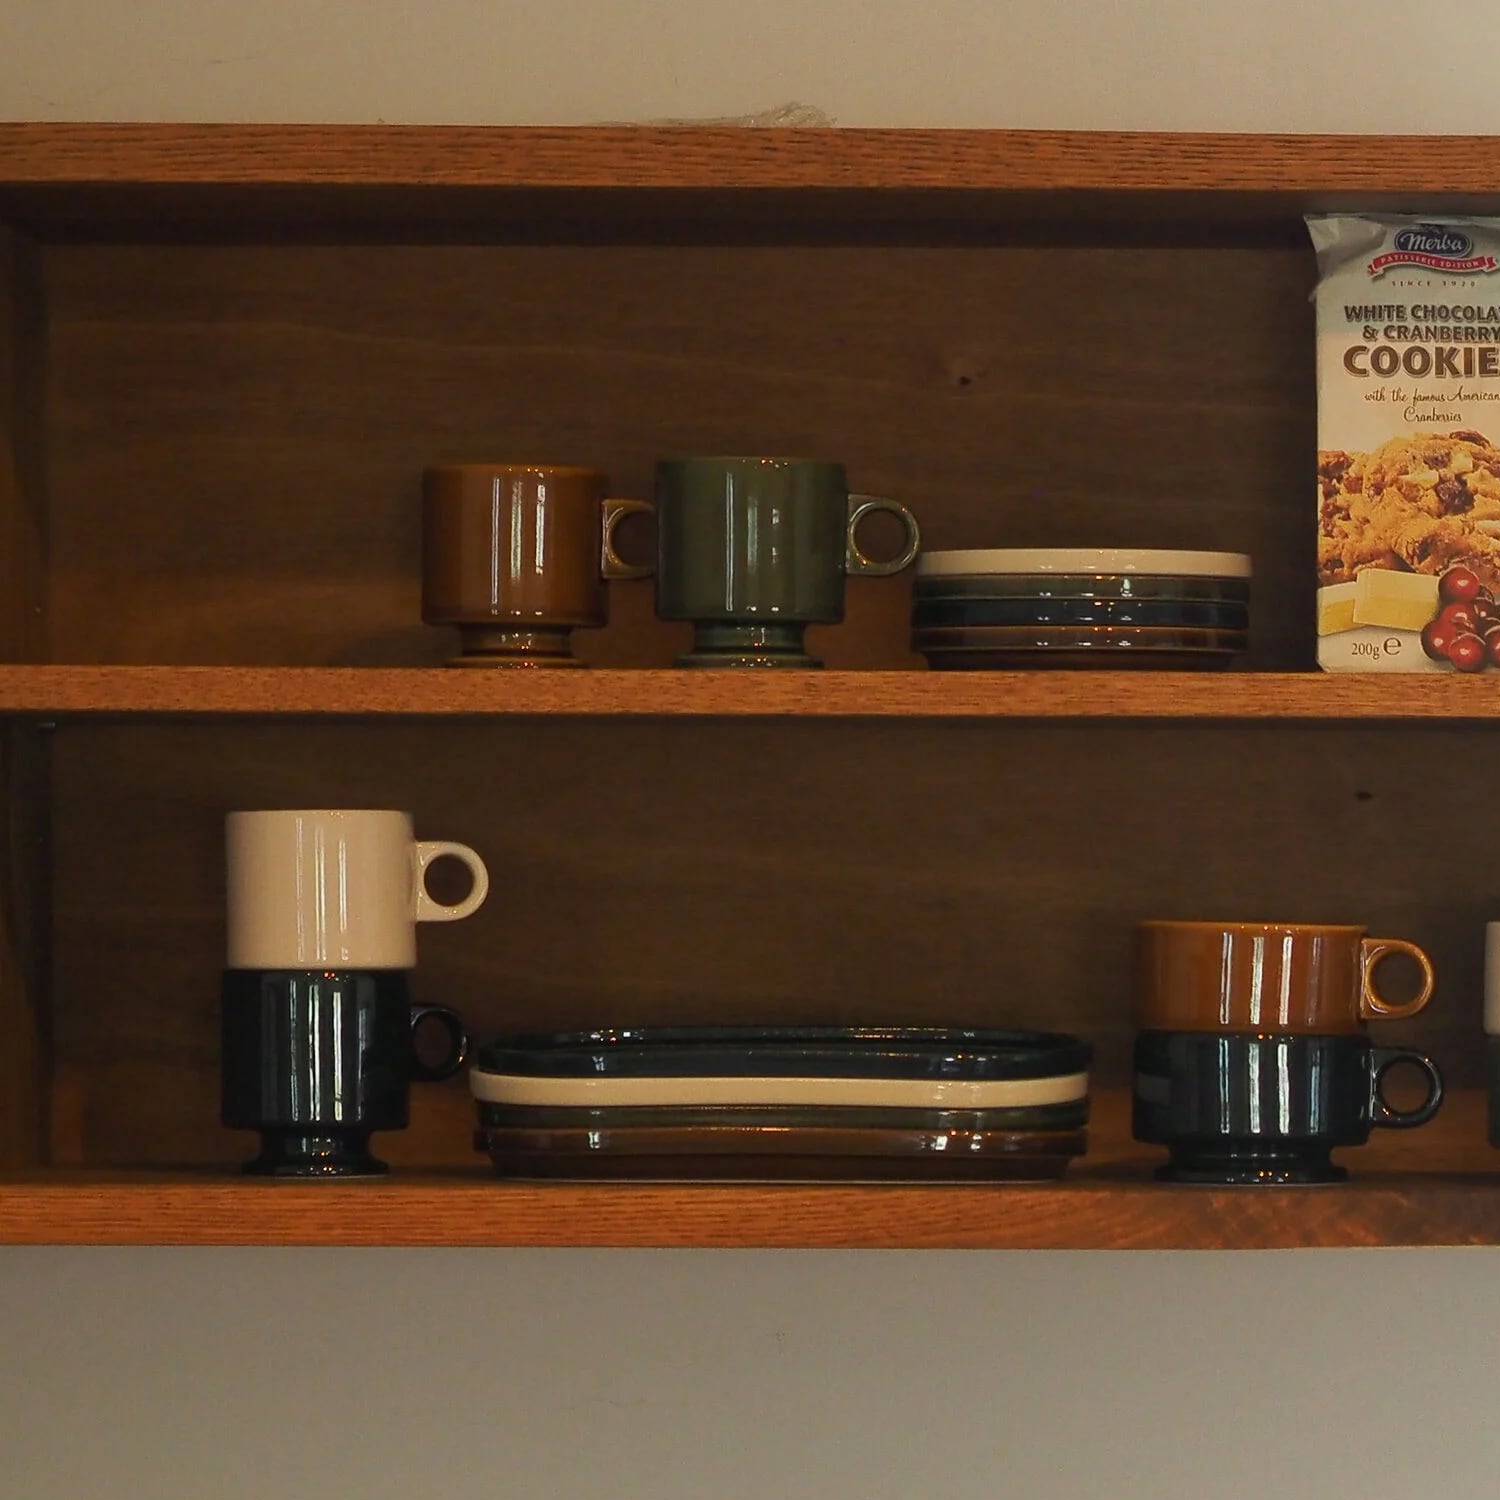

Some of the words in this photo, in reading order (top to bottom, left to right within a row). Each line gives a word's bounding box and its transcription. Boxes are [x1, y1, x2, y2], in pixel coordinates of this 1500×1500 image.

[1400, 232, 1464, 252] Merba
[1381, 253, 1436, 266] PATISSERIE
[1439, 259, 1480, 269] EDITION
[1344, 304, 1407, 323] WHITE
[1362, 324, 1378, 342] &
[1364, 386, 1387, 402] with
[1390, 387, 1408, 402] the
[1411, 388, 1446, 407] famous
[1403, 406, 1462, 422] Cranberries
[1352, 642, 1380, 660] 200g
